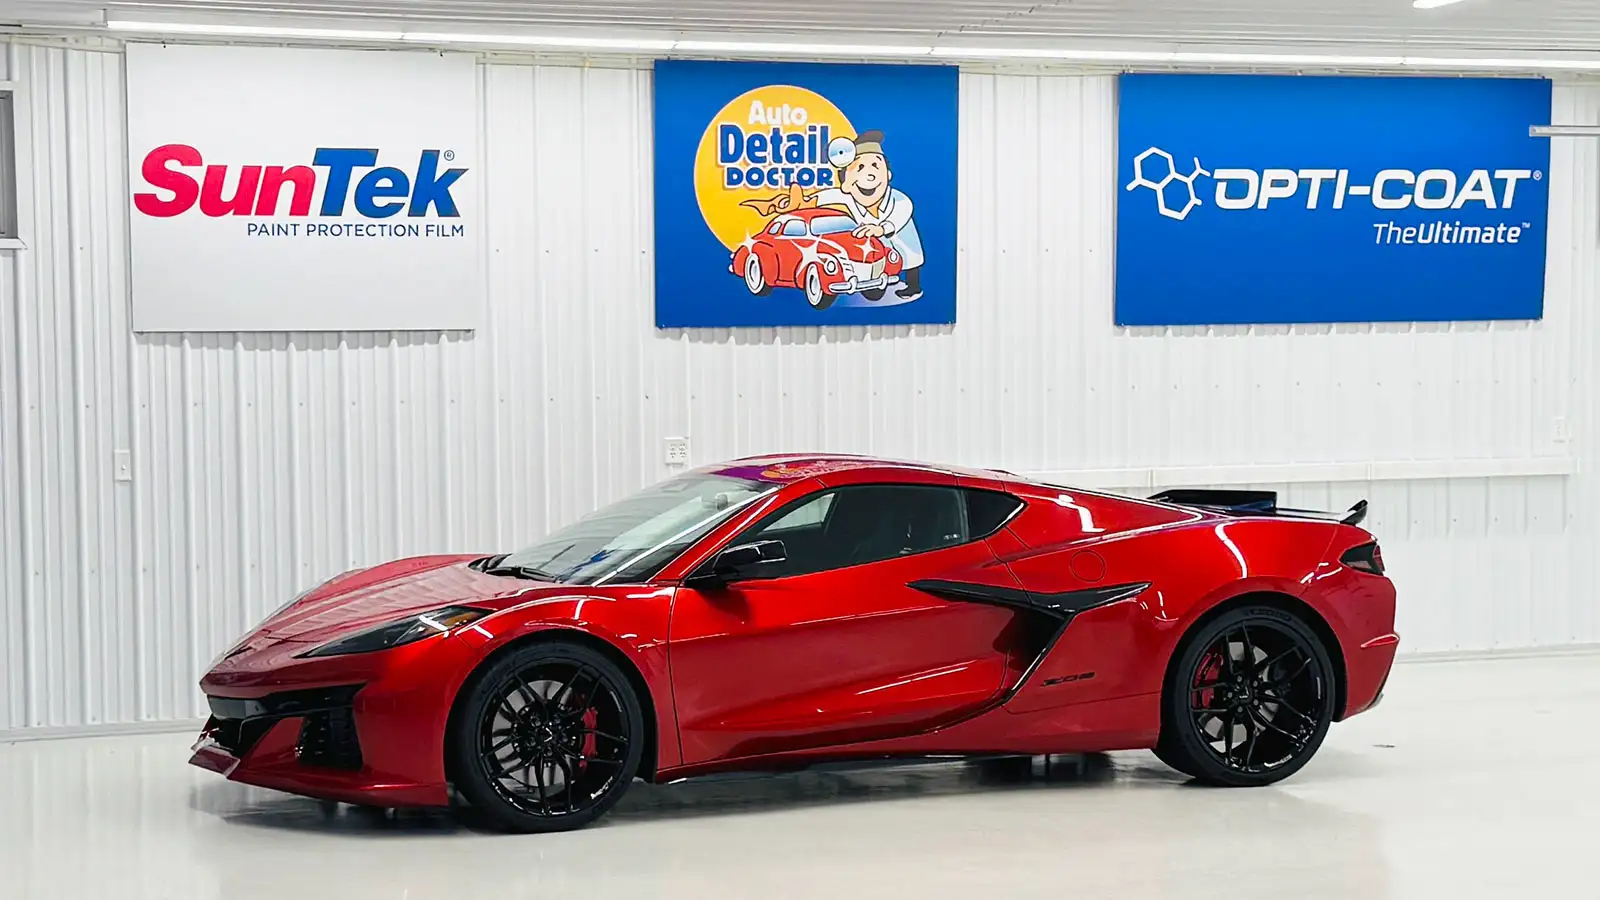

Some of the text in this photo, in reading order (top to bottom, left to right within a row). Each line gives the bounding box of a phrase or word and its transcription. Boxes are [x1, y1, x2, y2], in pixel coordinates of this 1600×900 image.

[750, 100, 807, 124] Auto
[718, 123, 831, 165] Detail
[726, 167, 833, 187] DOCTOR
[247, 223, 464, 237] PAINT PROTECTION FILM
